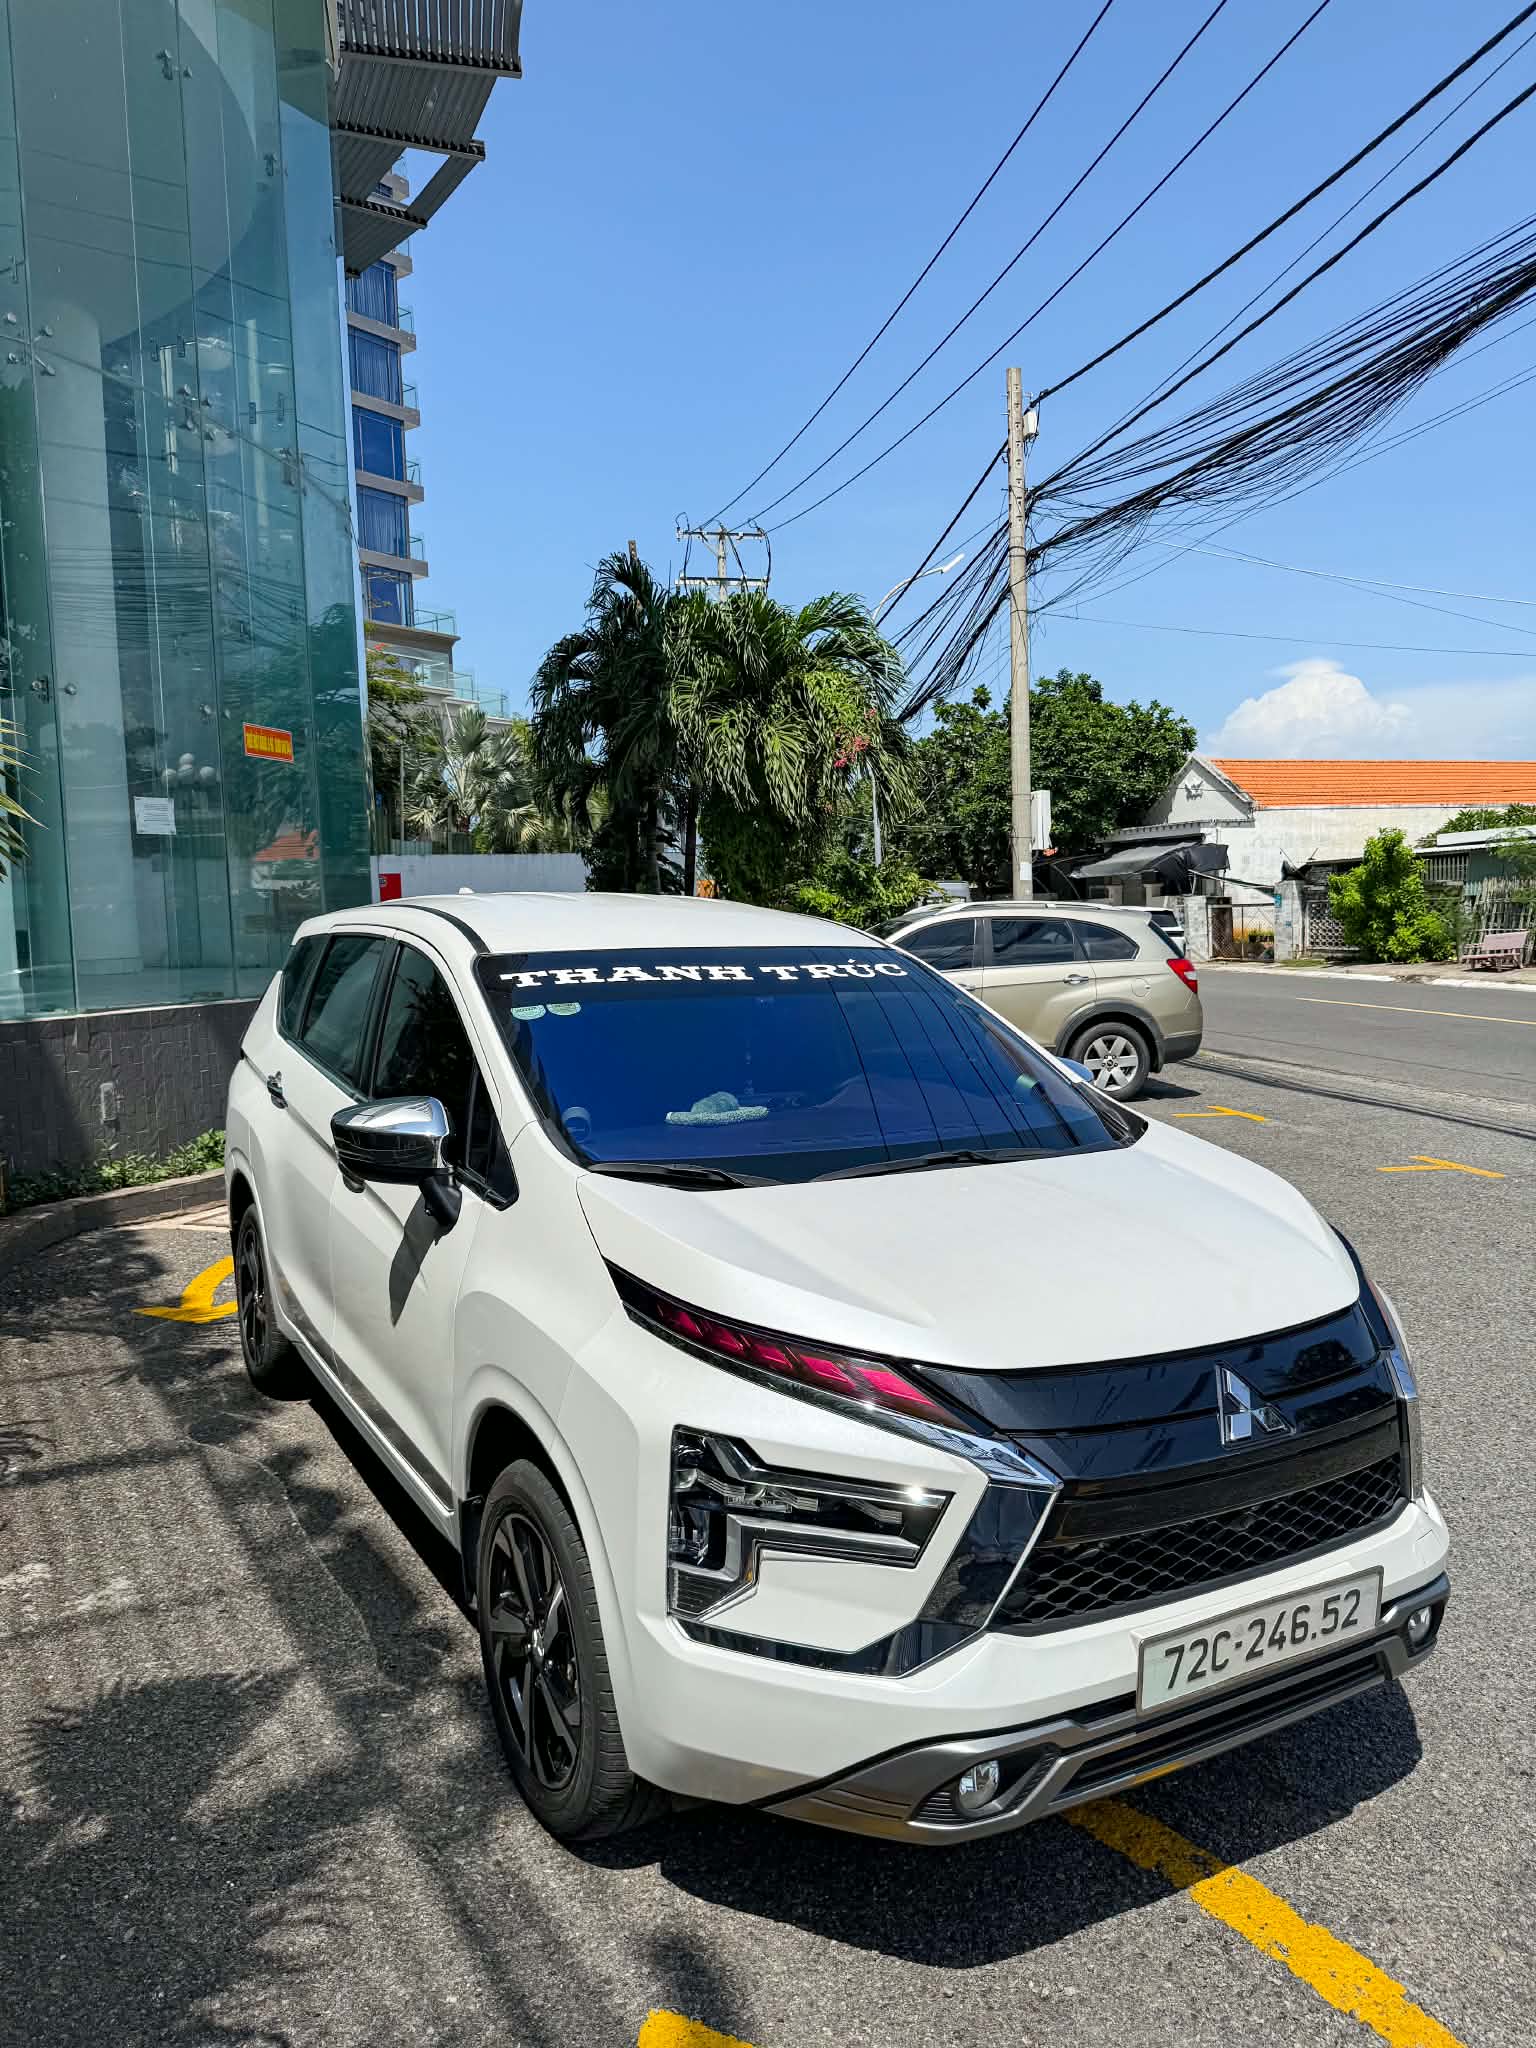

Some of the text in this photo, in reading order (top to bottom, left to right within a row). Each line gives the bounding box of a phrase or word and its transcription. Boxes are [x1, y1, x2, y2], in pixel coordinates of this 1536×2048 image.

[500, 958, 908, 988] THANH TRÚC
[1164, 1588, 1361, 1690] 72C-246.52
